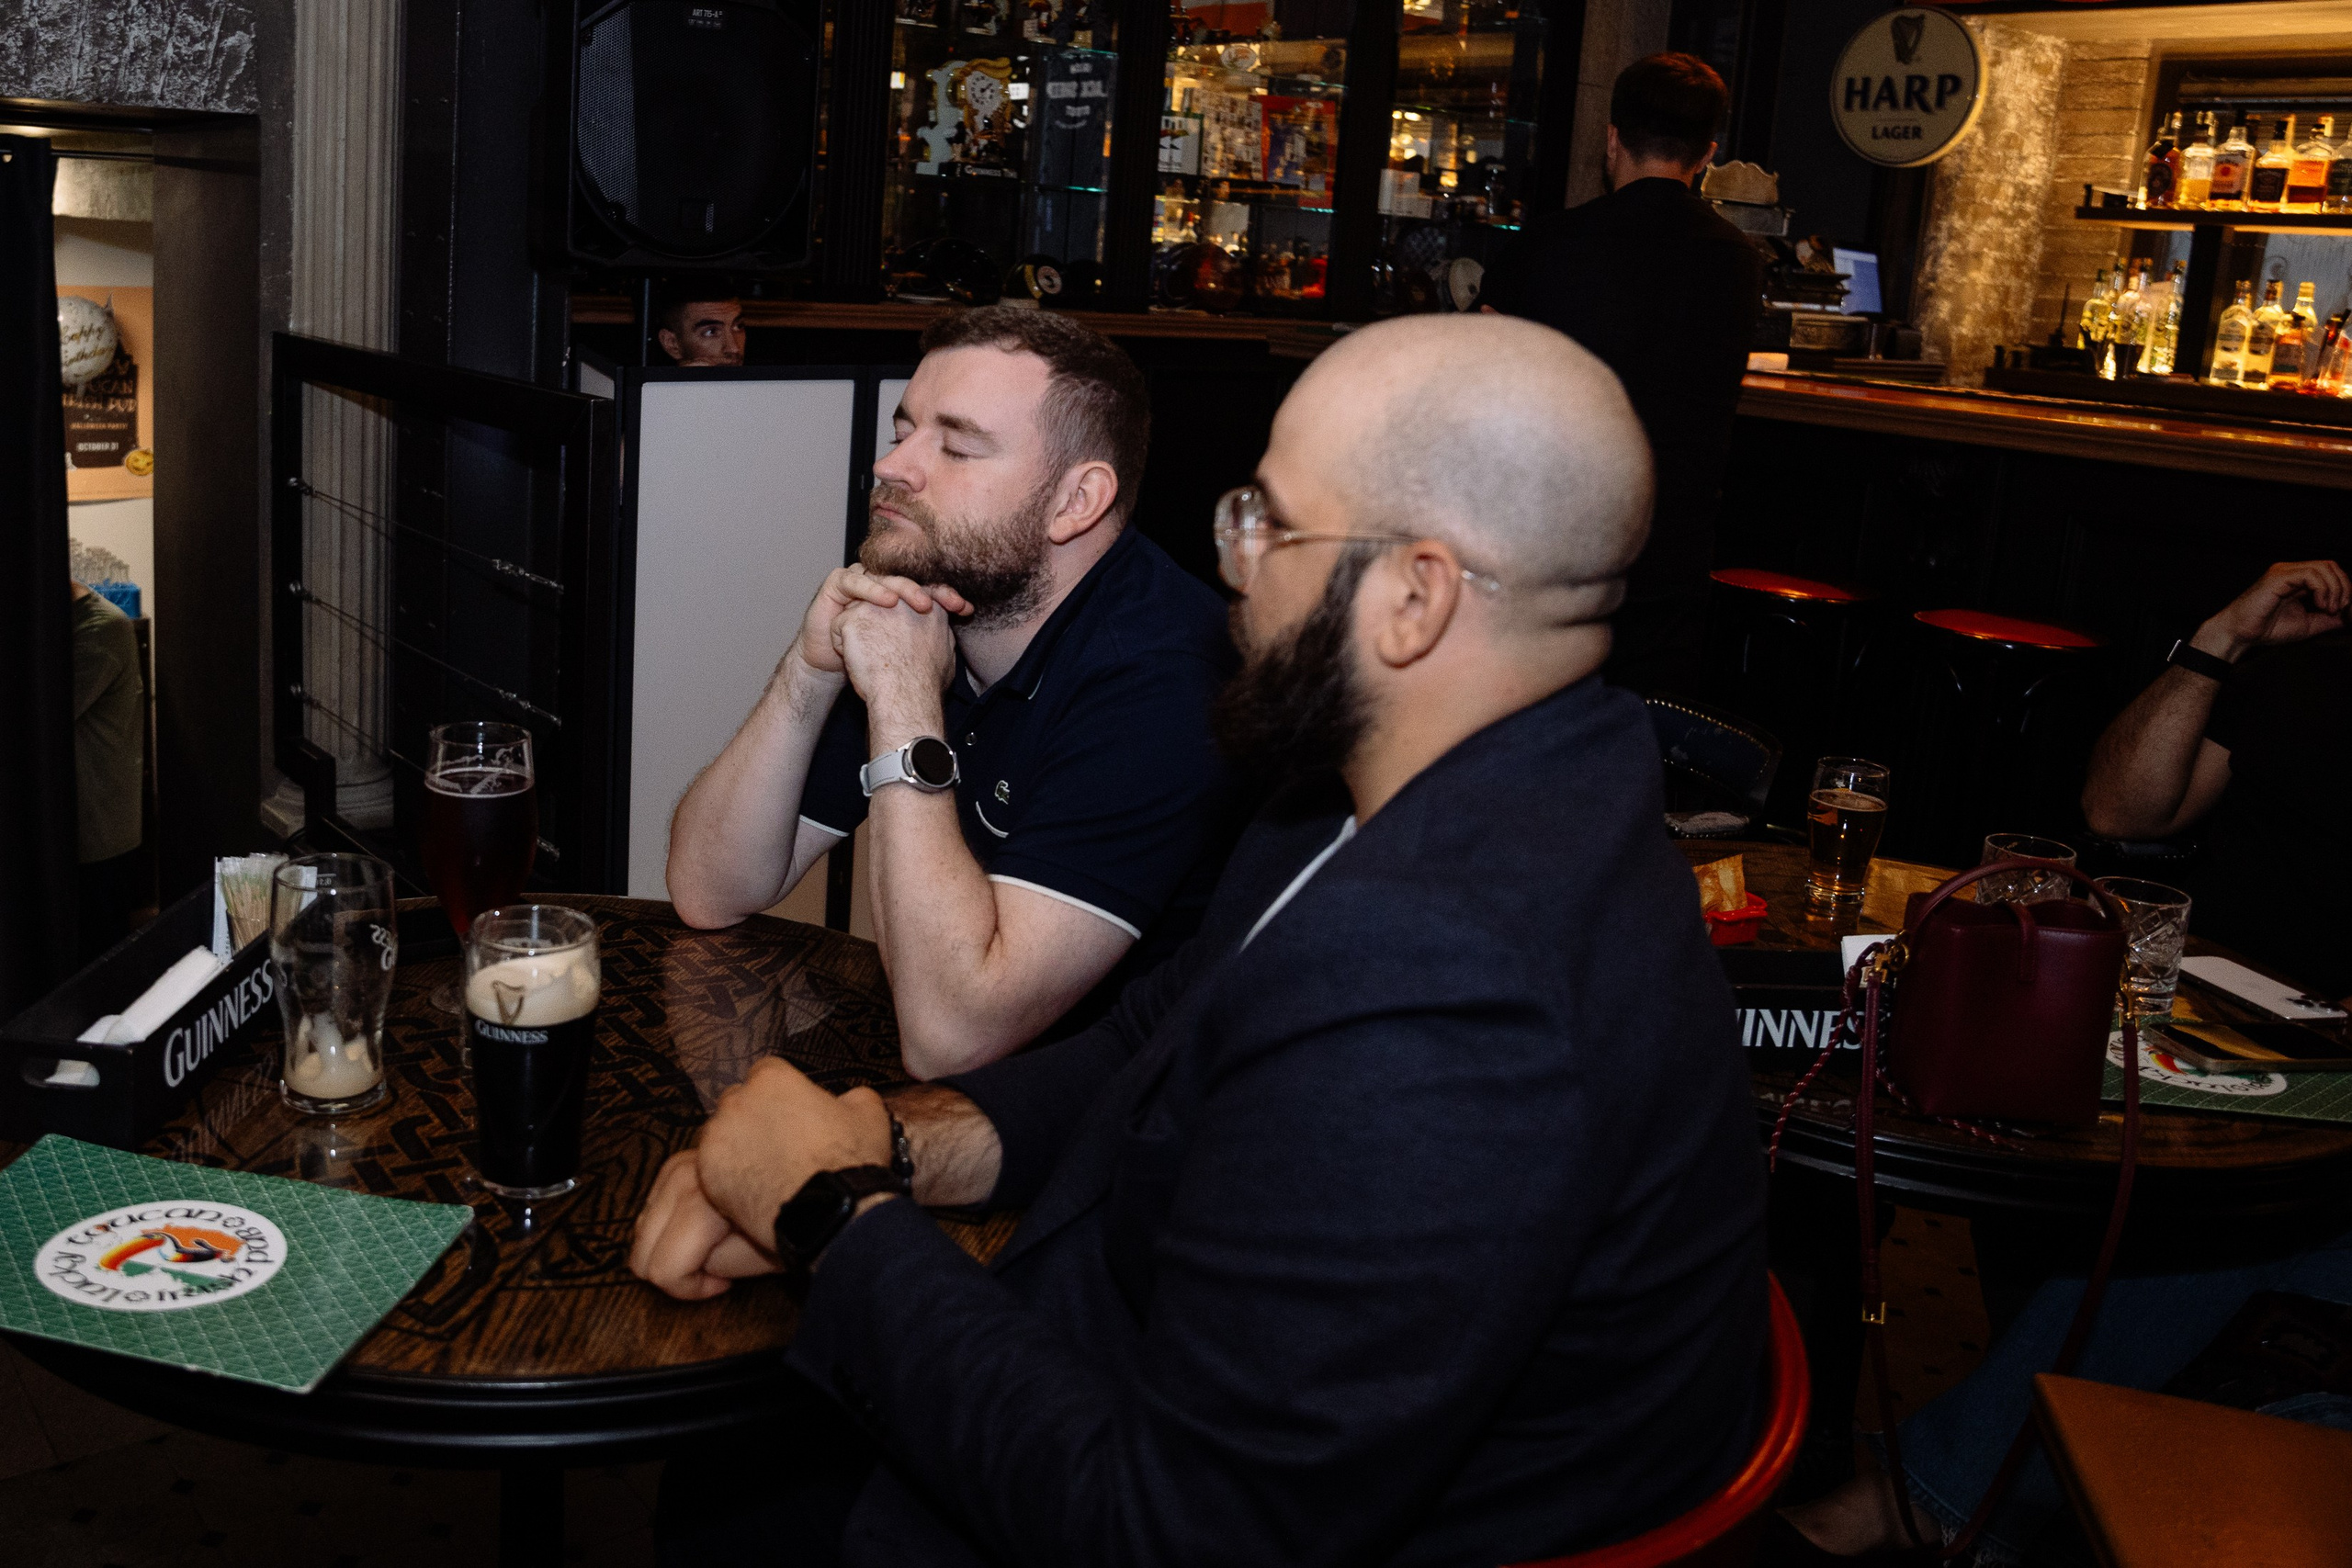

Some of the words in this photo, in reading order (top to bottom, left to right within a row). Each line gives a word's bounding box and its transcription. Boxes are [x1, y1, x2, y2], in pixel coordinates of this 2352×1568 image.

[1843, 73, 1962, 116] HARP
[1871, 125, 1922, 140] LAGER
[164, 958, 274, 1088] GUINNESS
[474, 1019, 548, 1045] GUINNESS
[1735, 1008, 1865, 1050] INNES
